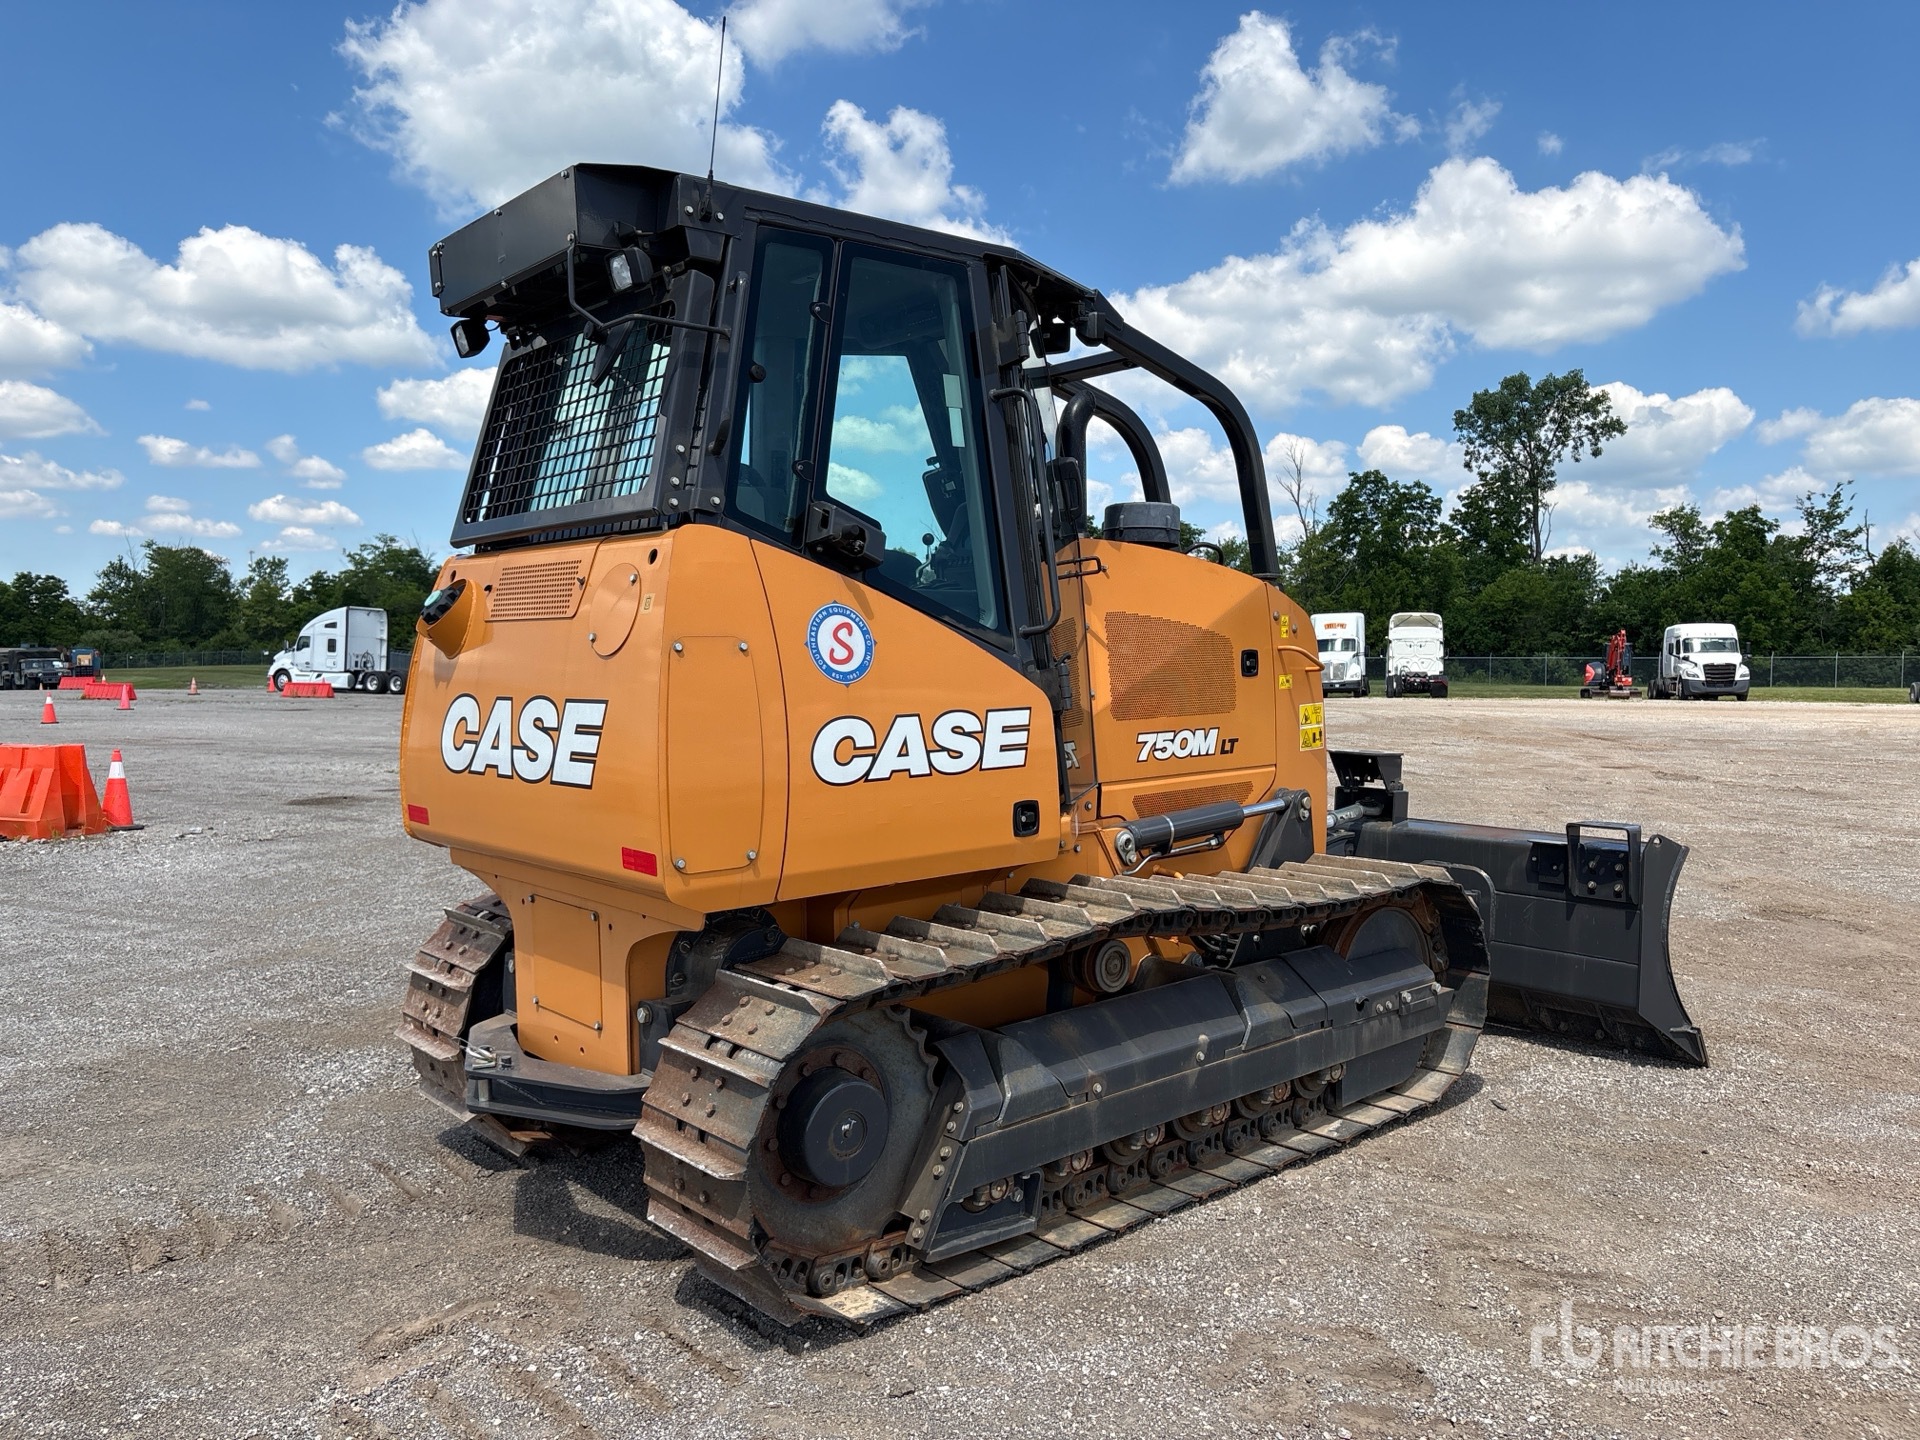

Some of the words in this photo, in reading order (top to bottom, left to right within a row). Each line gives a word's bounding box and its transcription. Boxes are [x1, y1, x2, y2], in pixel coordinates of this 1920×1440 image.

[810, 611, 827, 670] SOUTHEASTERN
[829, 607, 867, 631] EQUIPMENT
[829, 621, 854, 665] S
[440, 693, 609, 790] CASE
[811, 707, 1032, 786] CASE
[1136, 727, 1220, 763] 750M
[1220, 738, 1239, 755] LT
